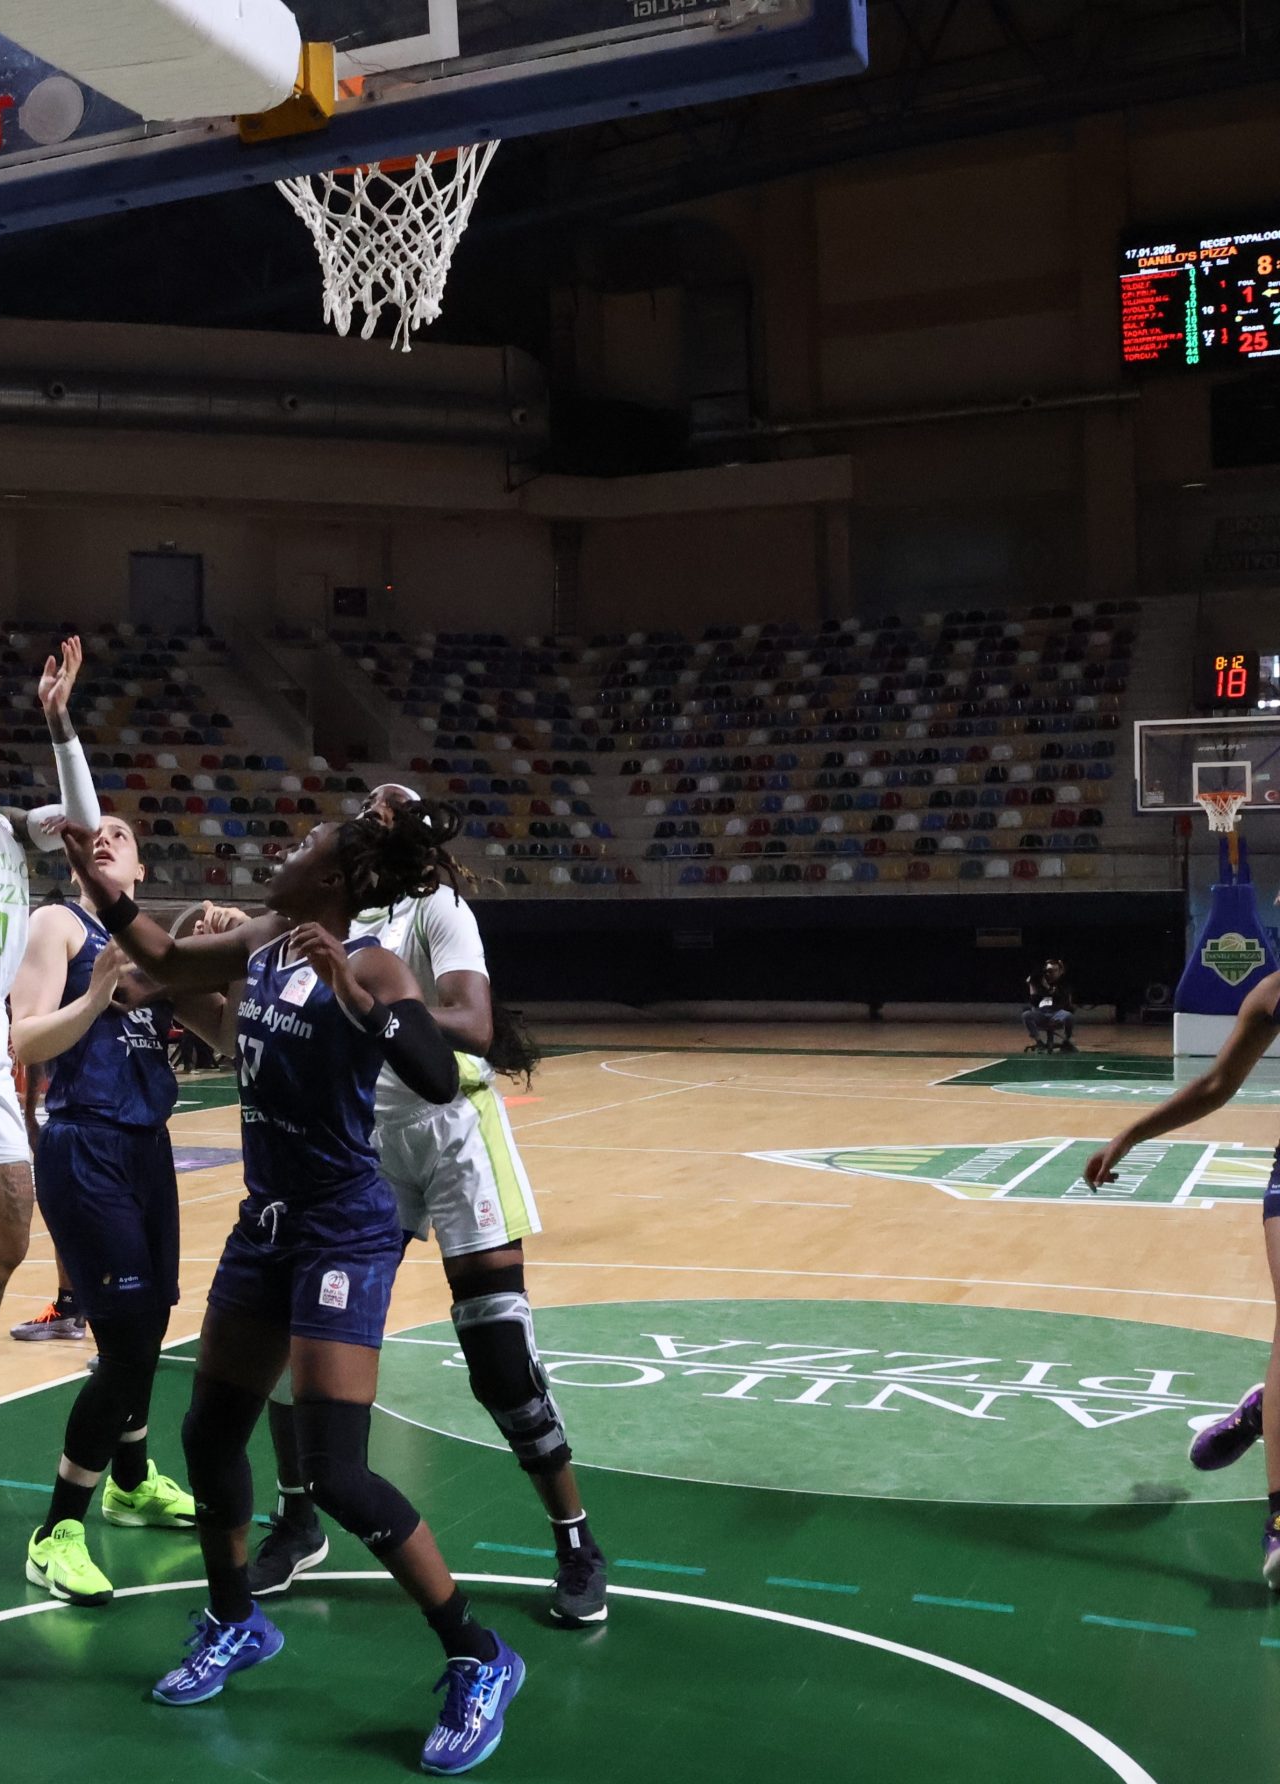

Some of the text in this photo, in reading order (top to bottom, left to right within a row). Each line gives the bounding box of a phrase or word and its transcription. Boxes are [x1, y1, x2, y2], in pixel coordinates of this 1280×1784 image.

[1200, 236, 1232, 250] RECEP
[1184, 300, 1197, 308] 10
[1241, 286, 1253, 304] 1
[1238, 331, 1269, 352] 25
[1215, 655, 1244, 670] 8:12
[1216, 668, 1247, 697] 18
[261, 1004, 313, 1039] Aydın
[237, 1033, 264, 1087] 17
[640, 1333, 1195, 1397] PIZZA
